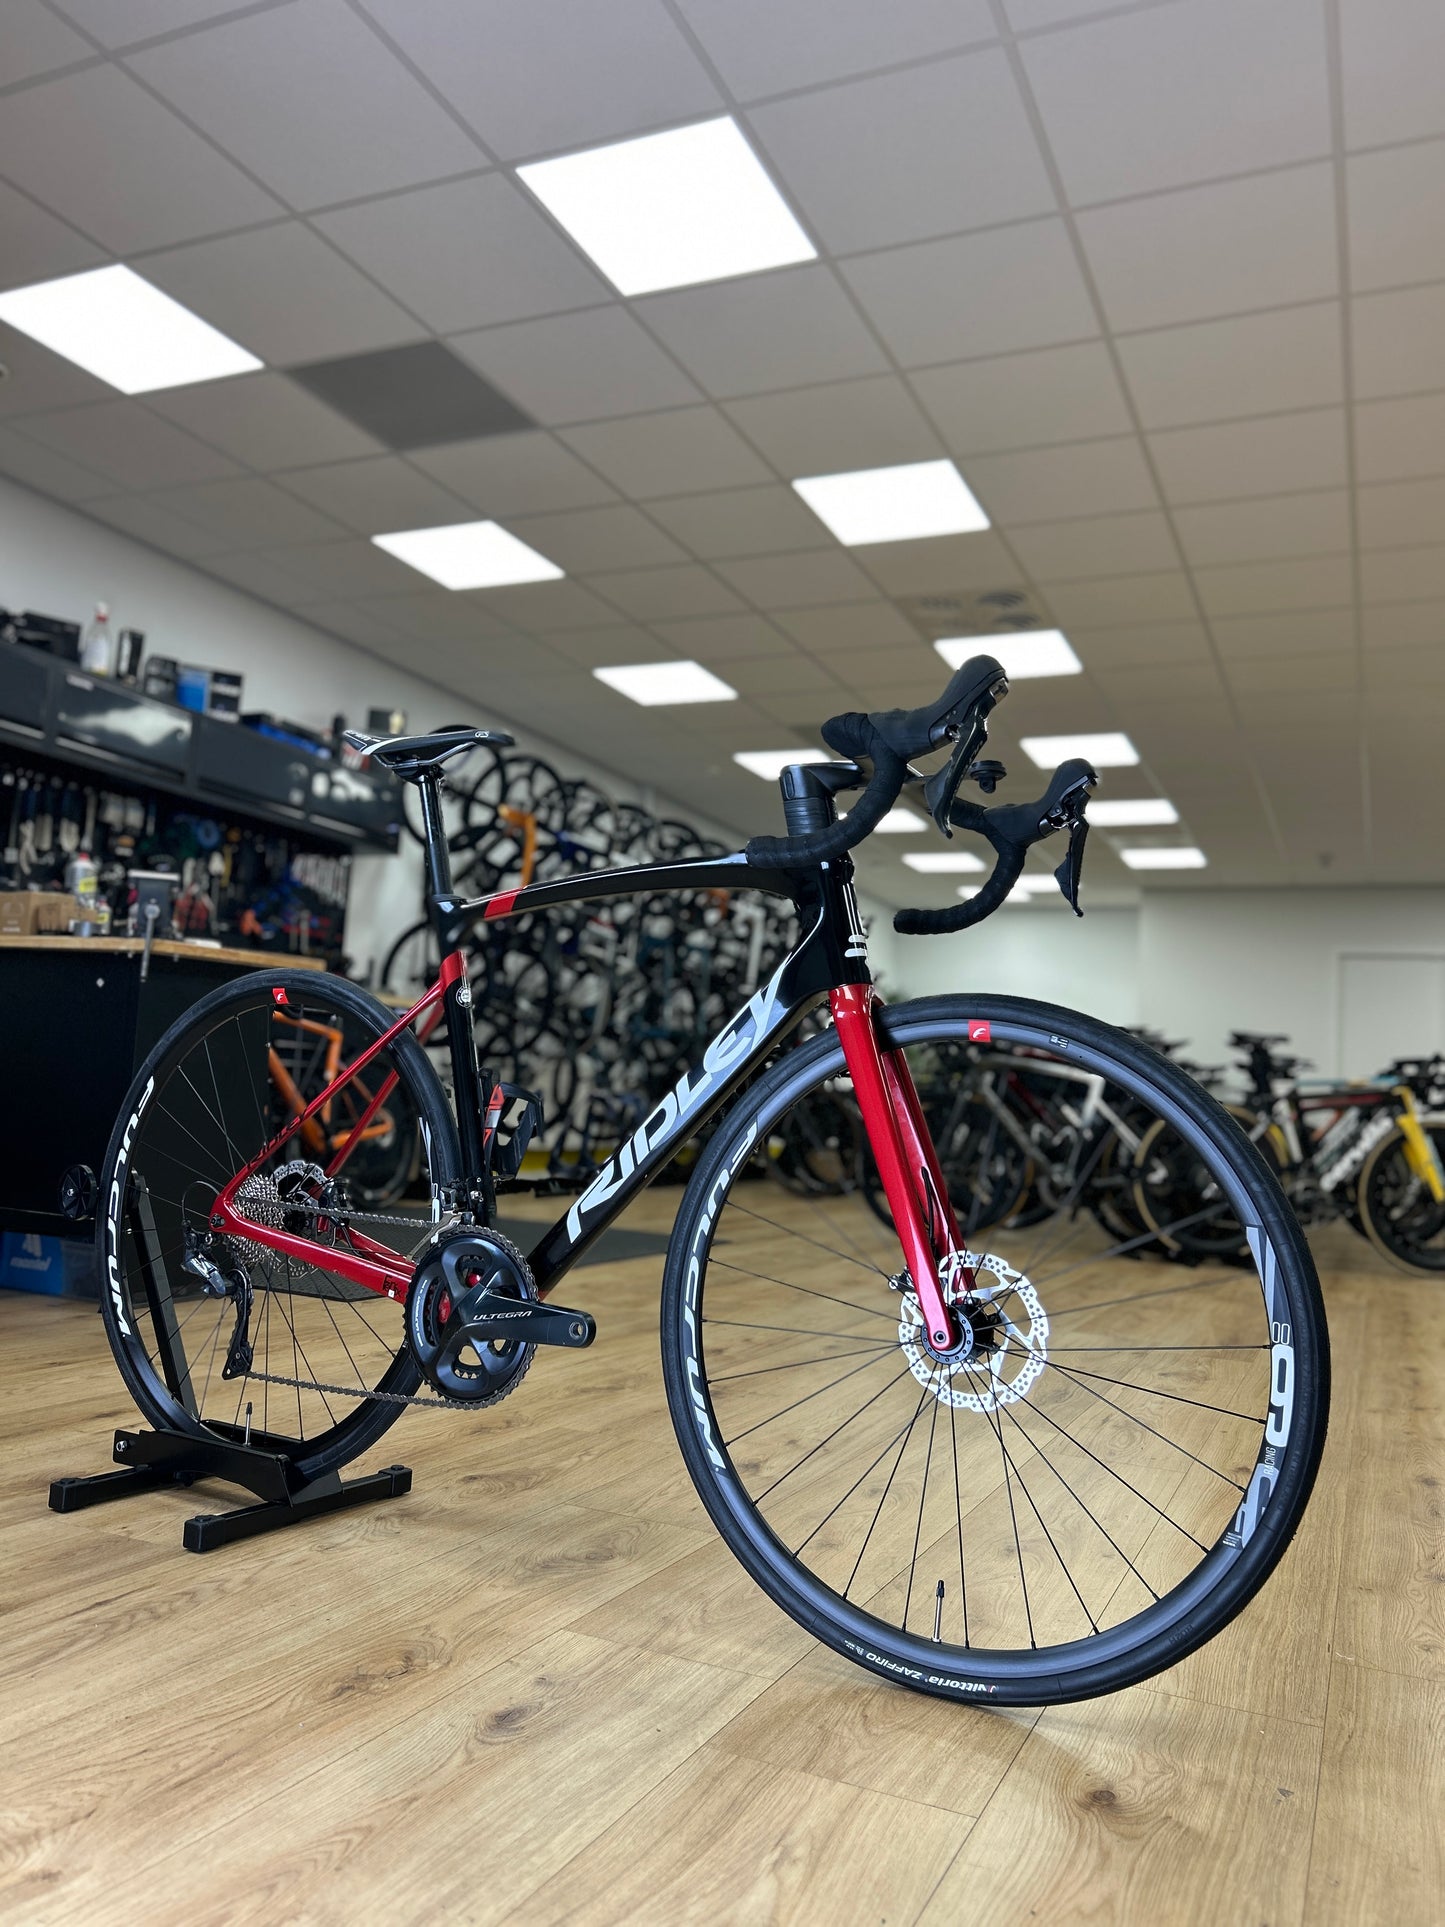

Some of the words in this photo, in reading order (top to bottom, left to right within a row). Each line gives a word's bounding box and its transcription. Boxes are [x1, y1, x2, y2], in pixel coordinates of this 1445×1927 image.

[566, 955, 791, 1244] RIDLEY
[106, 1076, 154, 1336] FULCRUM
[473, 1310, 533, 1321] ULTEGRA
[684, 1120, 758, 1470] FULCRUM
[1263, 1446, 1277, 1477] RACING
[865, 1652, 923, 1680] ZAFFIRO
